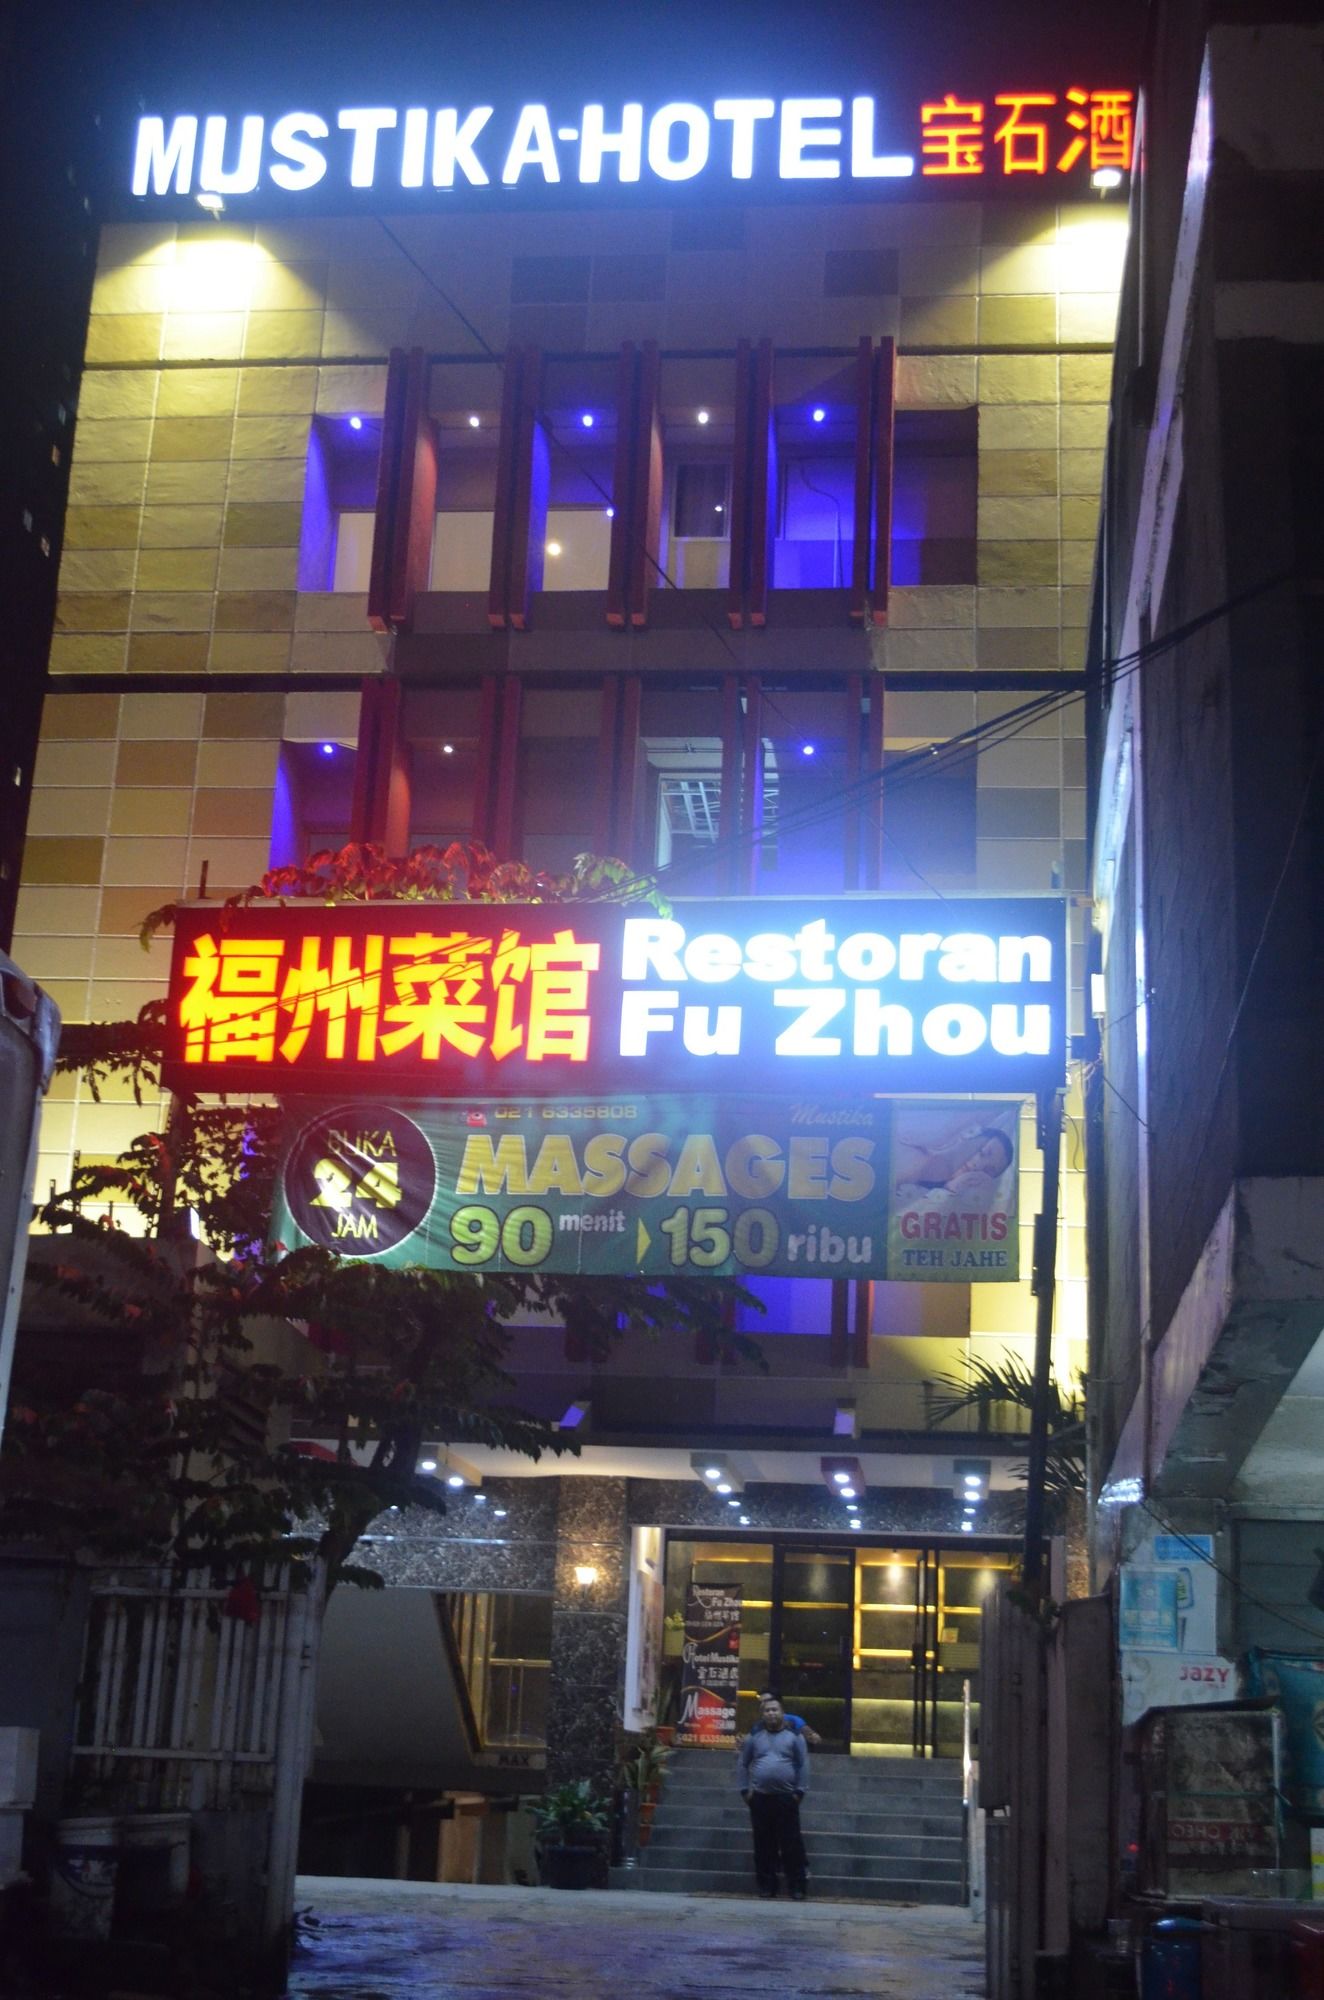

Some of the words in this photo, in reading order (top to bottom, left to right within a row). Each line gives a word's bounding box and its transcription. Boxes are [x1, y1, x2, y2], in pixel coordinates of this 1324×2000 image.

[921, 87, 1133, 175] 宝石酒
[621, 918, 1052, 983] Restoran
[180, 929, 600, 1063] 福州菜馆
[620, 990, 742, 1056] Fu
[773, 988, 1051, 1056] Zhou
[495, 1106, 533, 1119] 021
[542, 1105, 637, 1119] 6335808
[455, 1133, 876, 1202] MASSAGES
[331, 1213, 378, 1239] JAM
[450, 1204, 554, 1266] 90
[559, 1210, 626, 1233] menit
[660, 1206, 779, 1268] 150
[787, 1225, 872, 1264] ribu
[900, 1211, 1008, 1241] GRATIS
[902, 1250, 943, 1267] TEH
[951, 1250, 1007, 1267] JAHE
[677, 1692, 736, 1724] Massage
